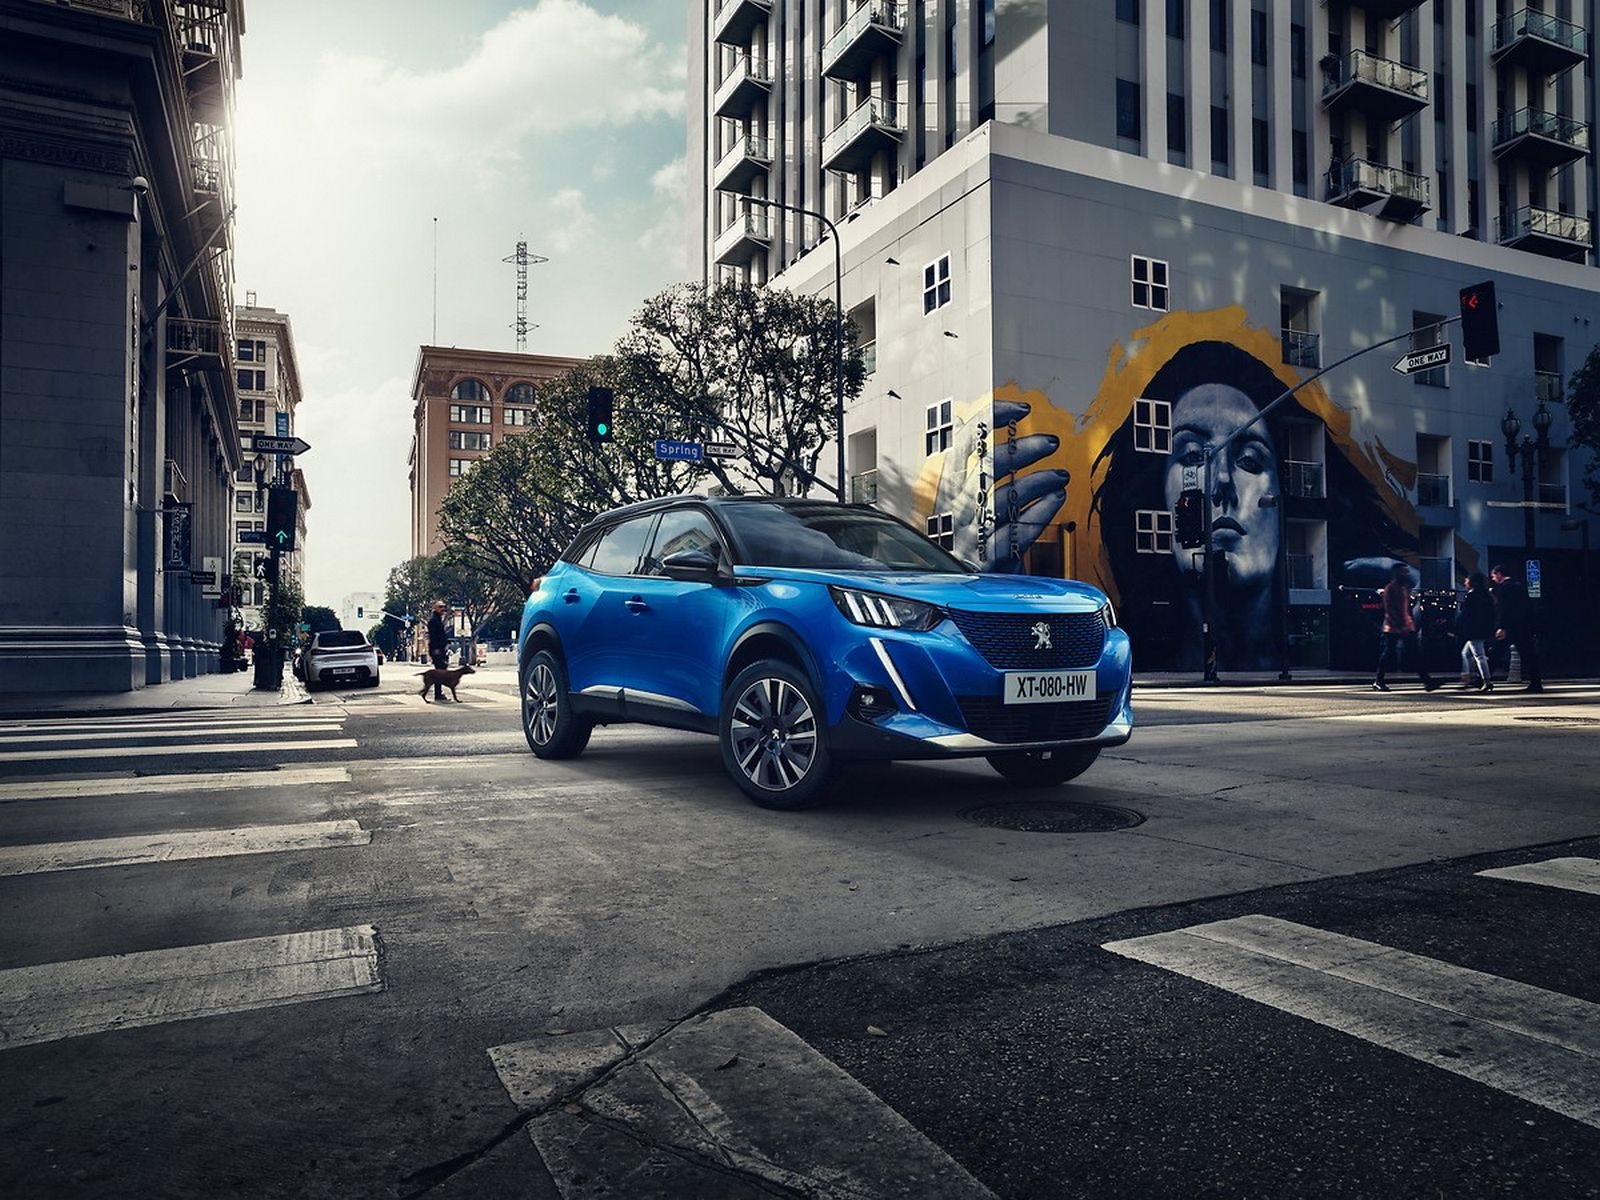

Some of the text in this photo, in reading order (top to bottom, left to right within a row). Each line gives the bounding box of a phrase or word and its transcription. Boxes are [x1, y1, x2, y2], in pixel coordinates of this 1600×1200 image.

[1409, 351, 1444, 367] ONE WAY
[258, 440, 294, 450] ONE WAY
[660, 444, 698, 458] Spring
[1008, 469, 1020, 560] TOWER
[1017, 675, 1087, 698] XT-080-HW
